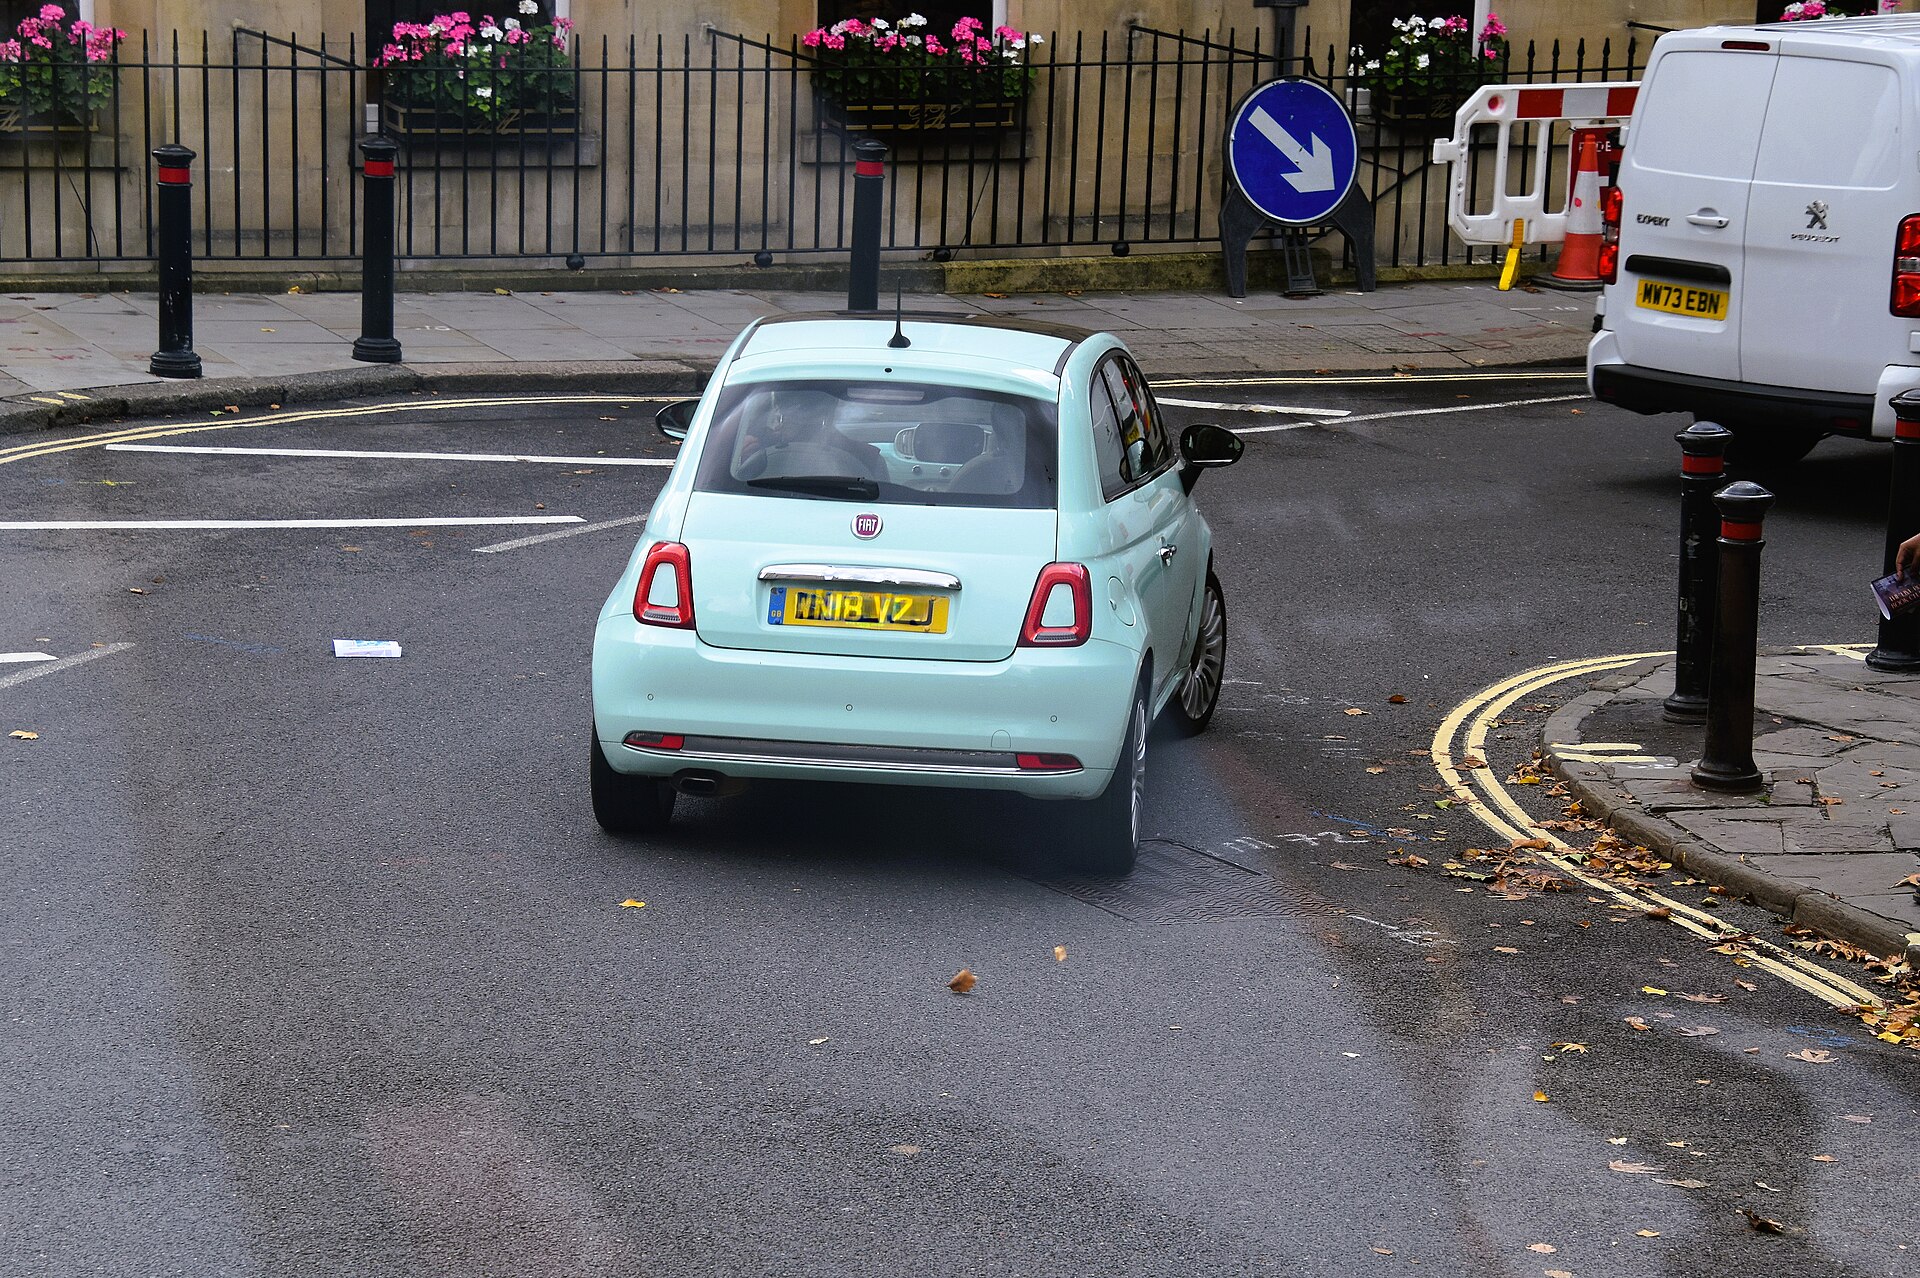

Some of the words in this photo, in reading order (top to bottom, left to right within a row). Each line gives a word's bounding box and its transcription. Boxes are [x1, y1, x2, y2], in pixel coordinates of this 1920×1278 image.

[1636, 213, 1671, 227] EXPERT
[1642, 282, 1683, 309] MW73
[1685, 289, 1721, 315] EBN
[857, 518, 878, 532] FIAT
